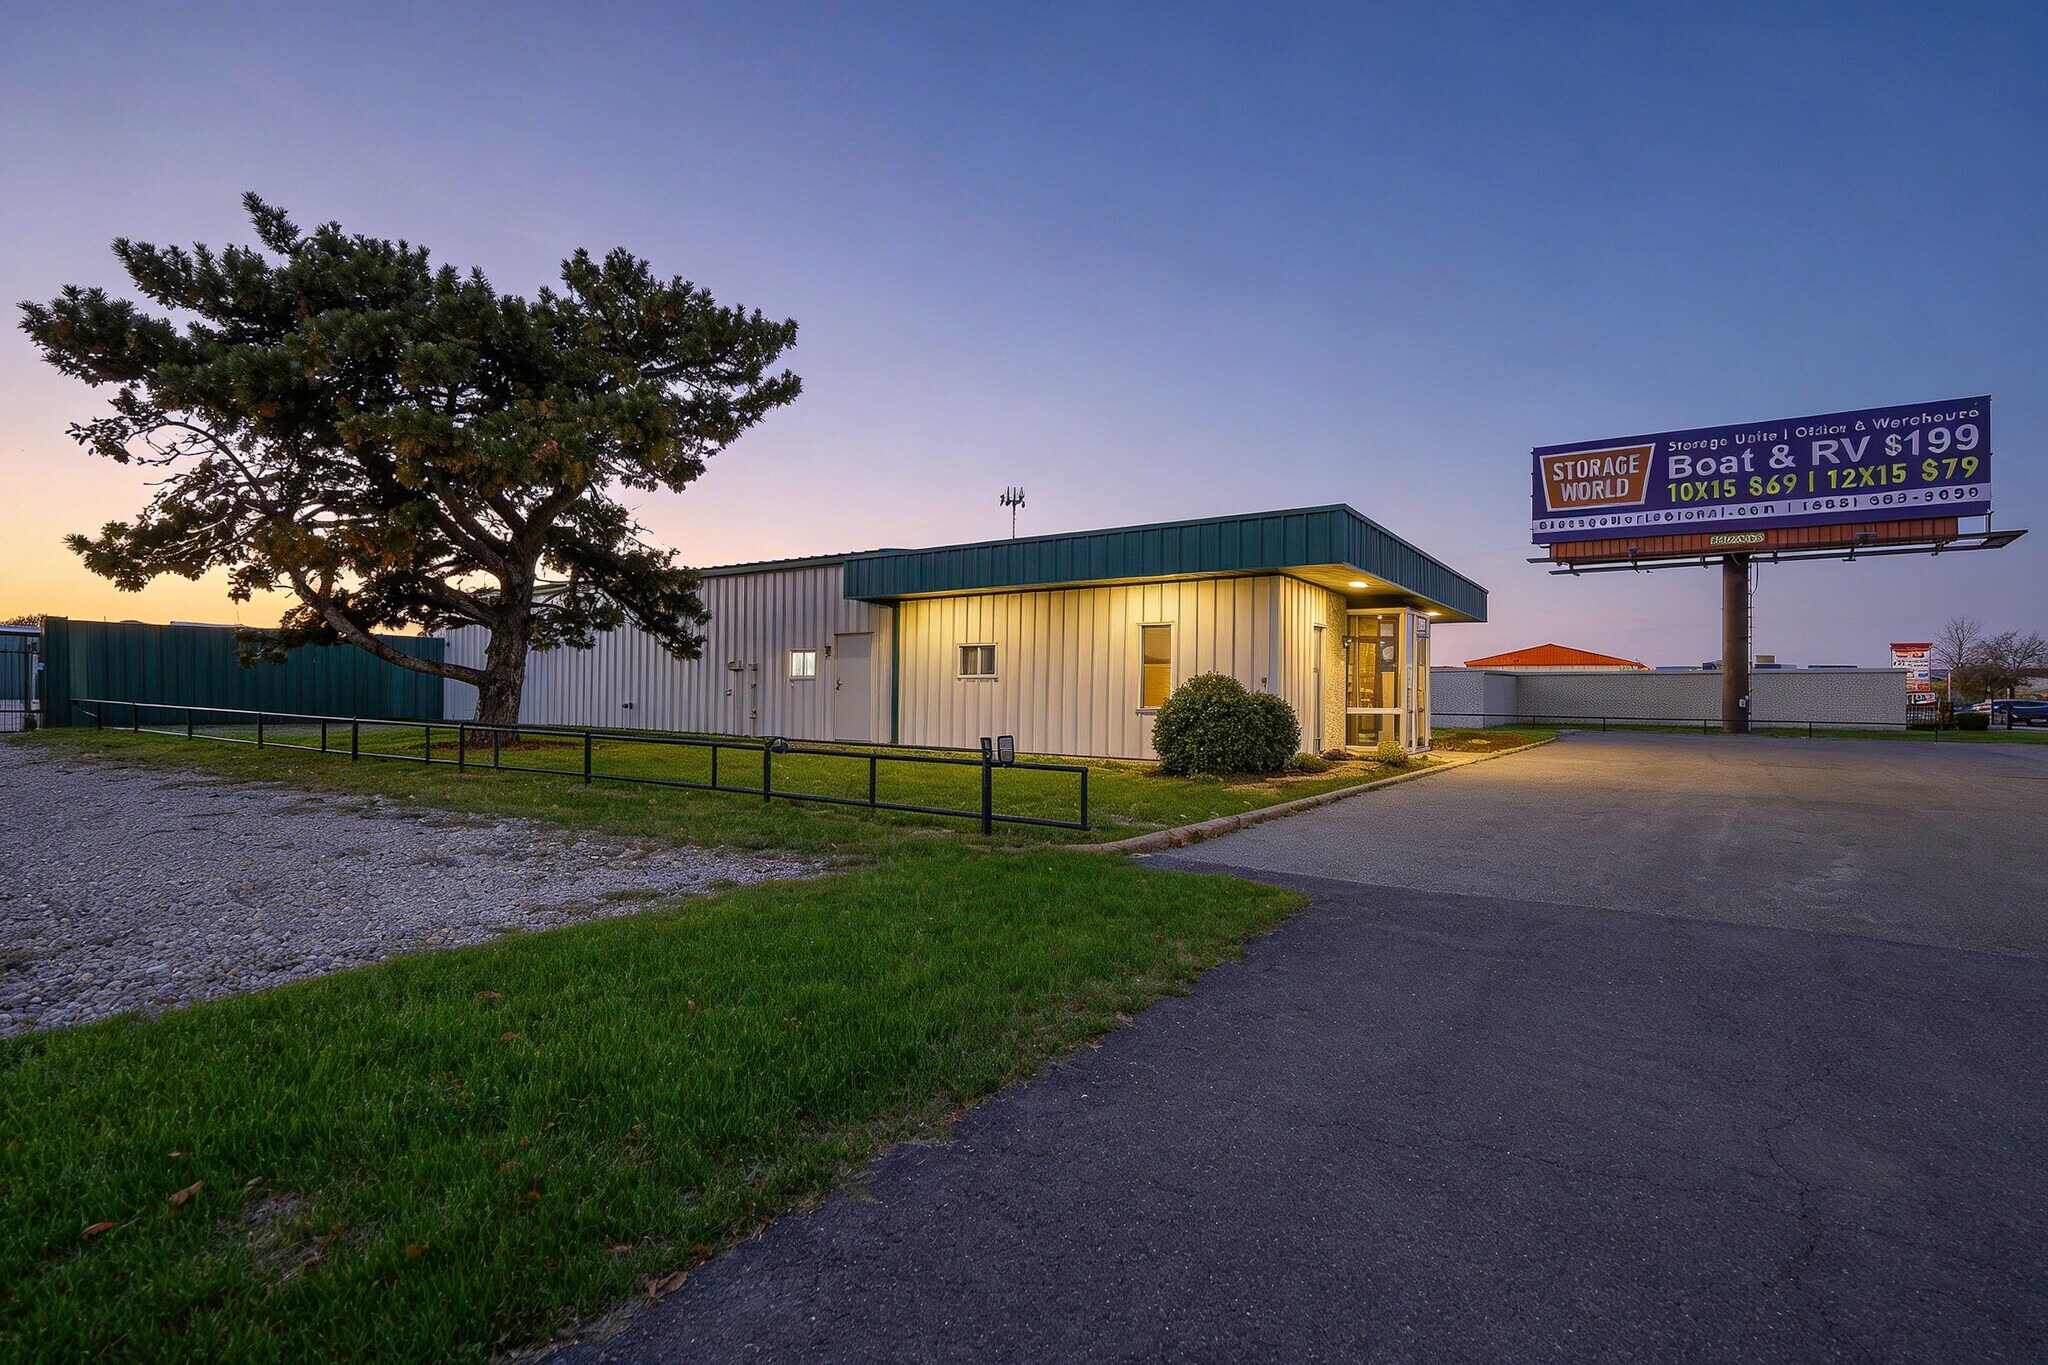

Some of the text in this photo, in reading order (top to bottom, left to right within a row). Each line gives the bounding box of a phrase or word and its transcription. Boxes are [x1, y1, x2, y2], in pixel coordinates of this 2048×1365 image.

[1553, 453, 1640, 481] STORAGE
[1668, 447, 1755, 480] Boat
[1769, 444, 1797, 469] &
[1811, 435, 1871, 466] RV
[1884, 423, 1980, 457] $199
[1561, 478, 1630, 502] WORLD
[1667, 478, 1737, 502] 10X15
[1827, 463, 1907, 489] 12X15
[1921, 456, 1979, 482] $79
